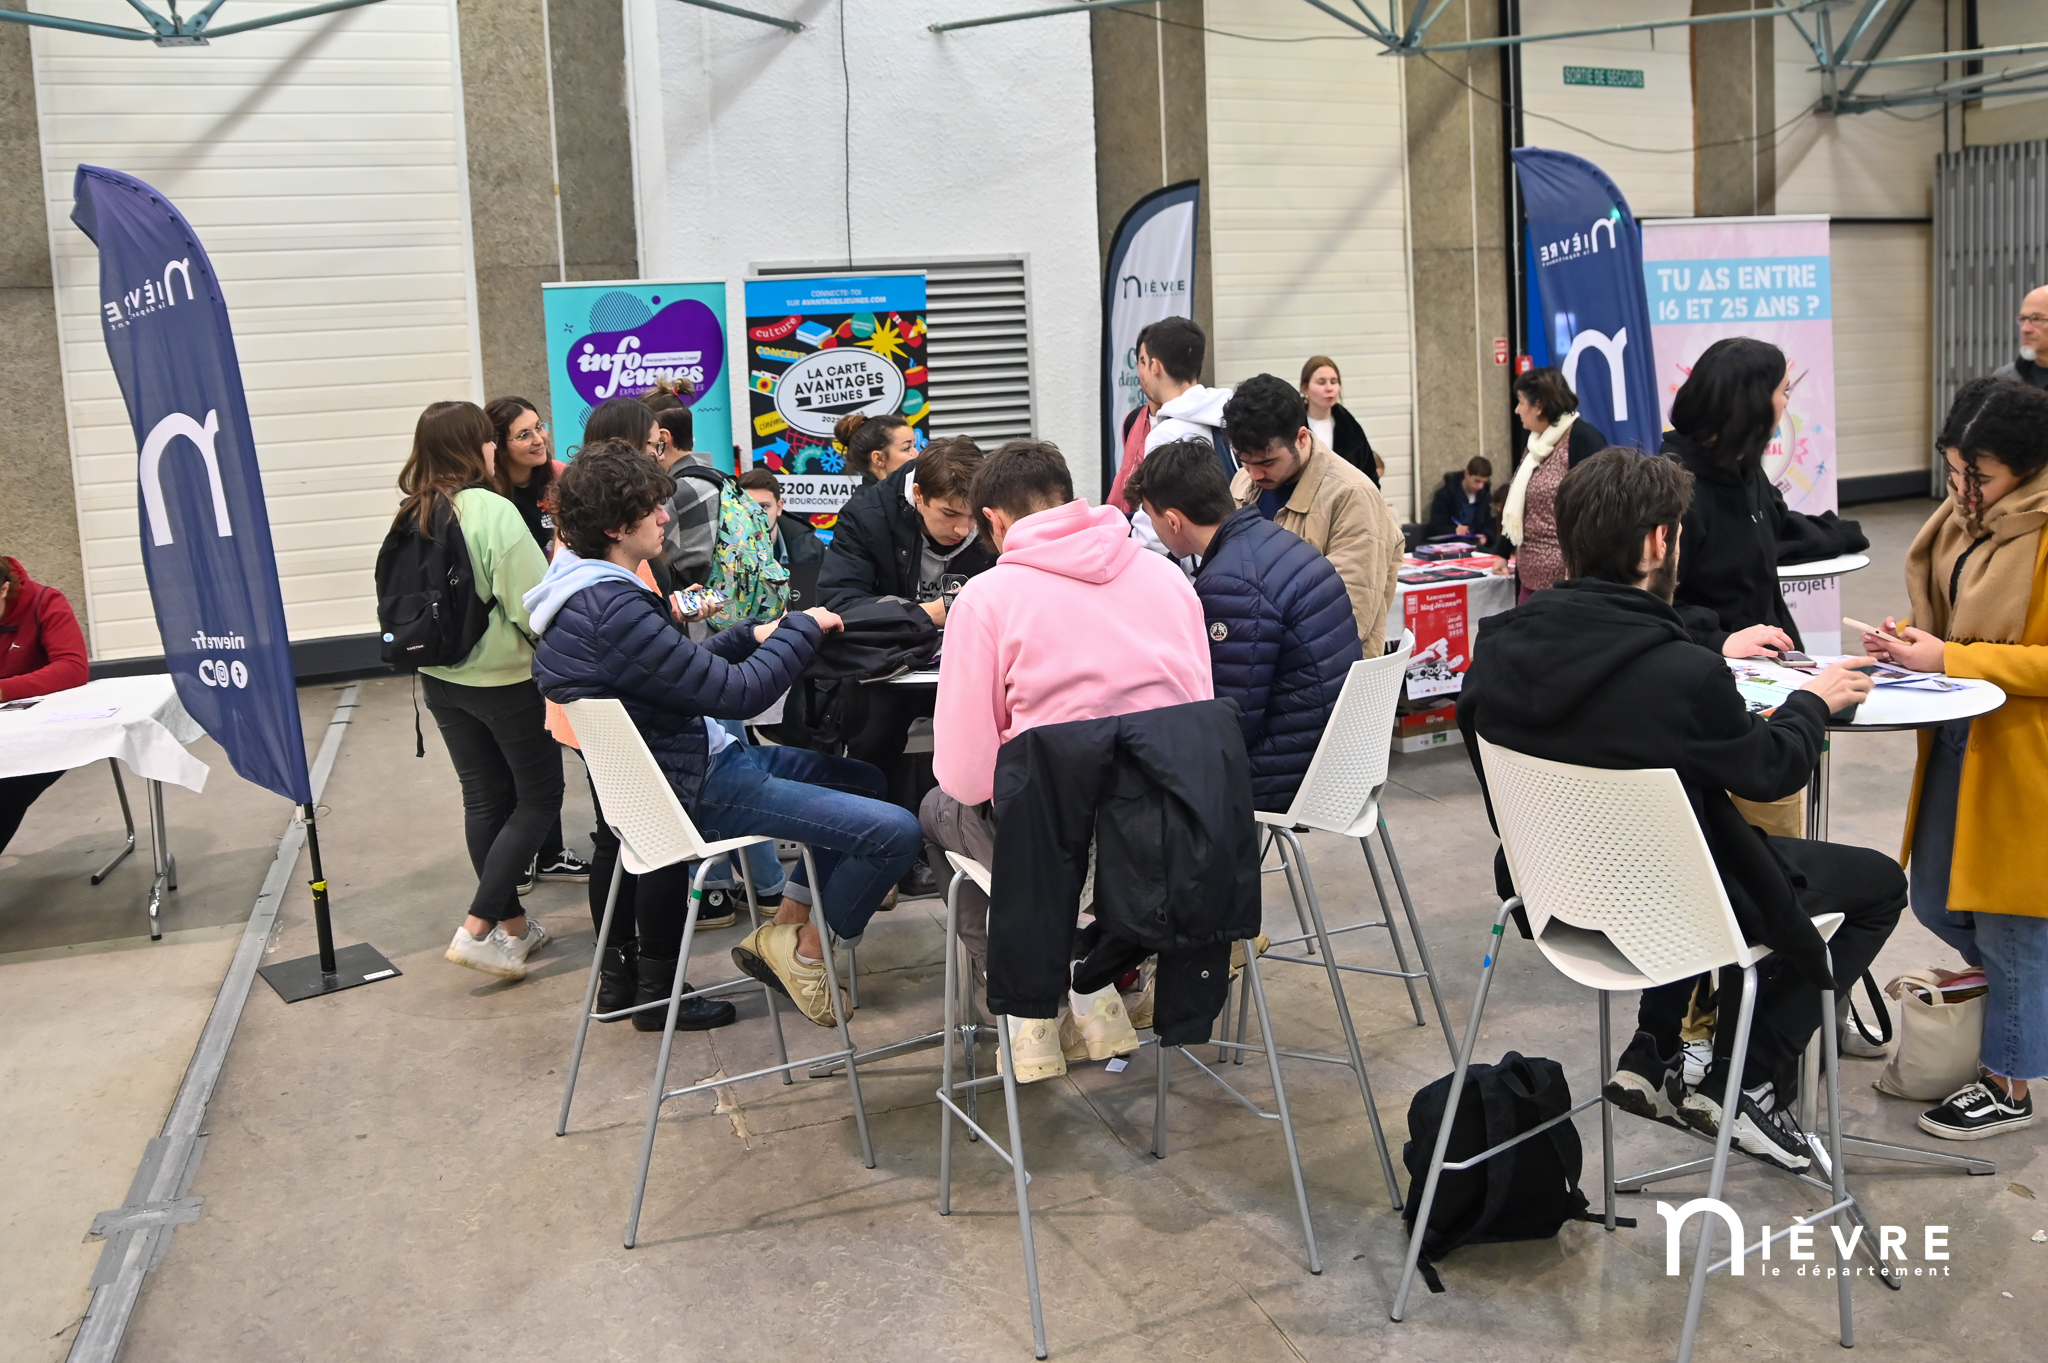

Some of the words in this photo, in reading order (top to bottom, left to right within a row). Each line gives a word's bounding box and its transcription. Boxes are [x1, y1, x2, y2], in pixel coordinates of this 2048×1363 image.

[1657, 267, 1691, 292] TU
[1697, 266, 1731, 291] AS
[1738, 264, 1817, 290] ENTRE
[786, 299, 801, 307] SUR
[801, 296, 887, 306] AVANTAGESJEUNES.COM
[811, 289, 862, 298] CONNECTE-TOI
[1658, 299, 1680, 321] 16
[1686, 298, 1714, 320] ET
[1720, 296, 1748, 319] 25
[1754, 295, 1800, 318] ANS
[807, 368, 824, 380] LA
[827, 361, 868, 377] CARTE
[794, 371, 885, 397] AVANTAGES
[818, 389, 864, 405] JEUNES
[1782, 578, 1827, 597] projet
[1743, 1100, 1762, 1121] new
[1758, 1119, 1794, 1149] balance
